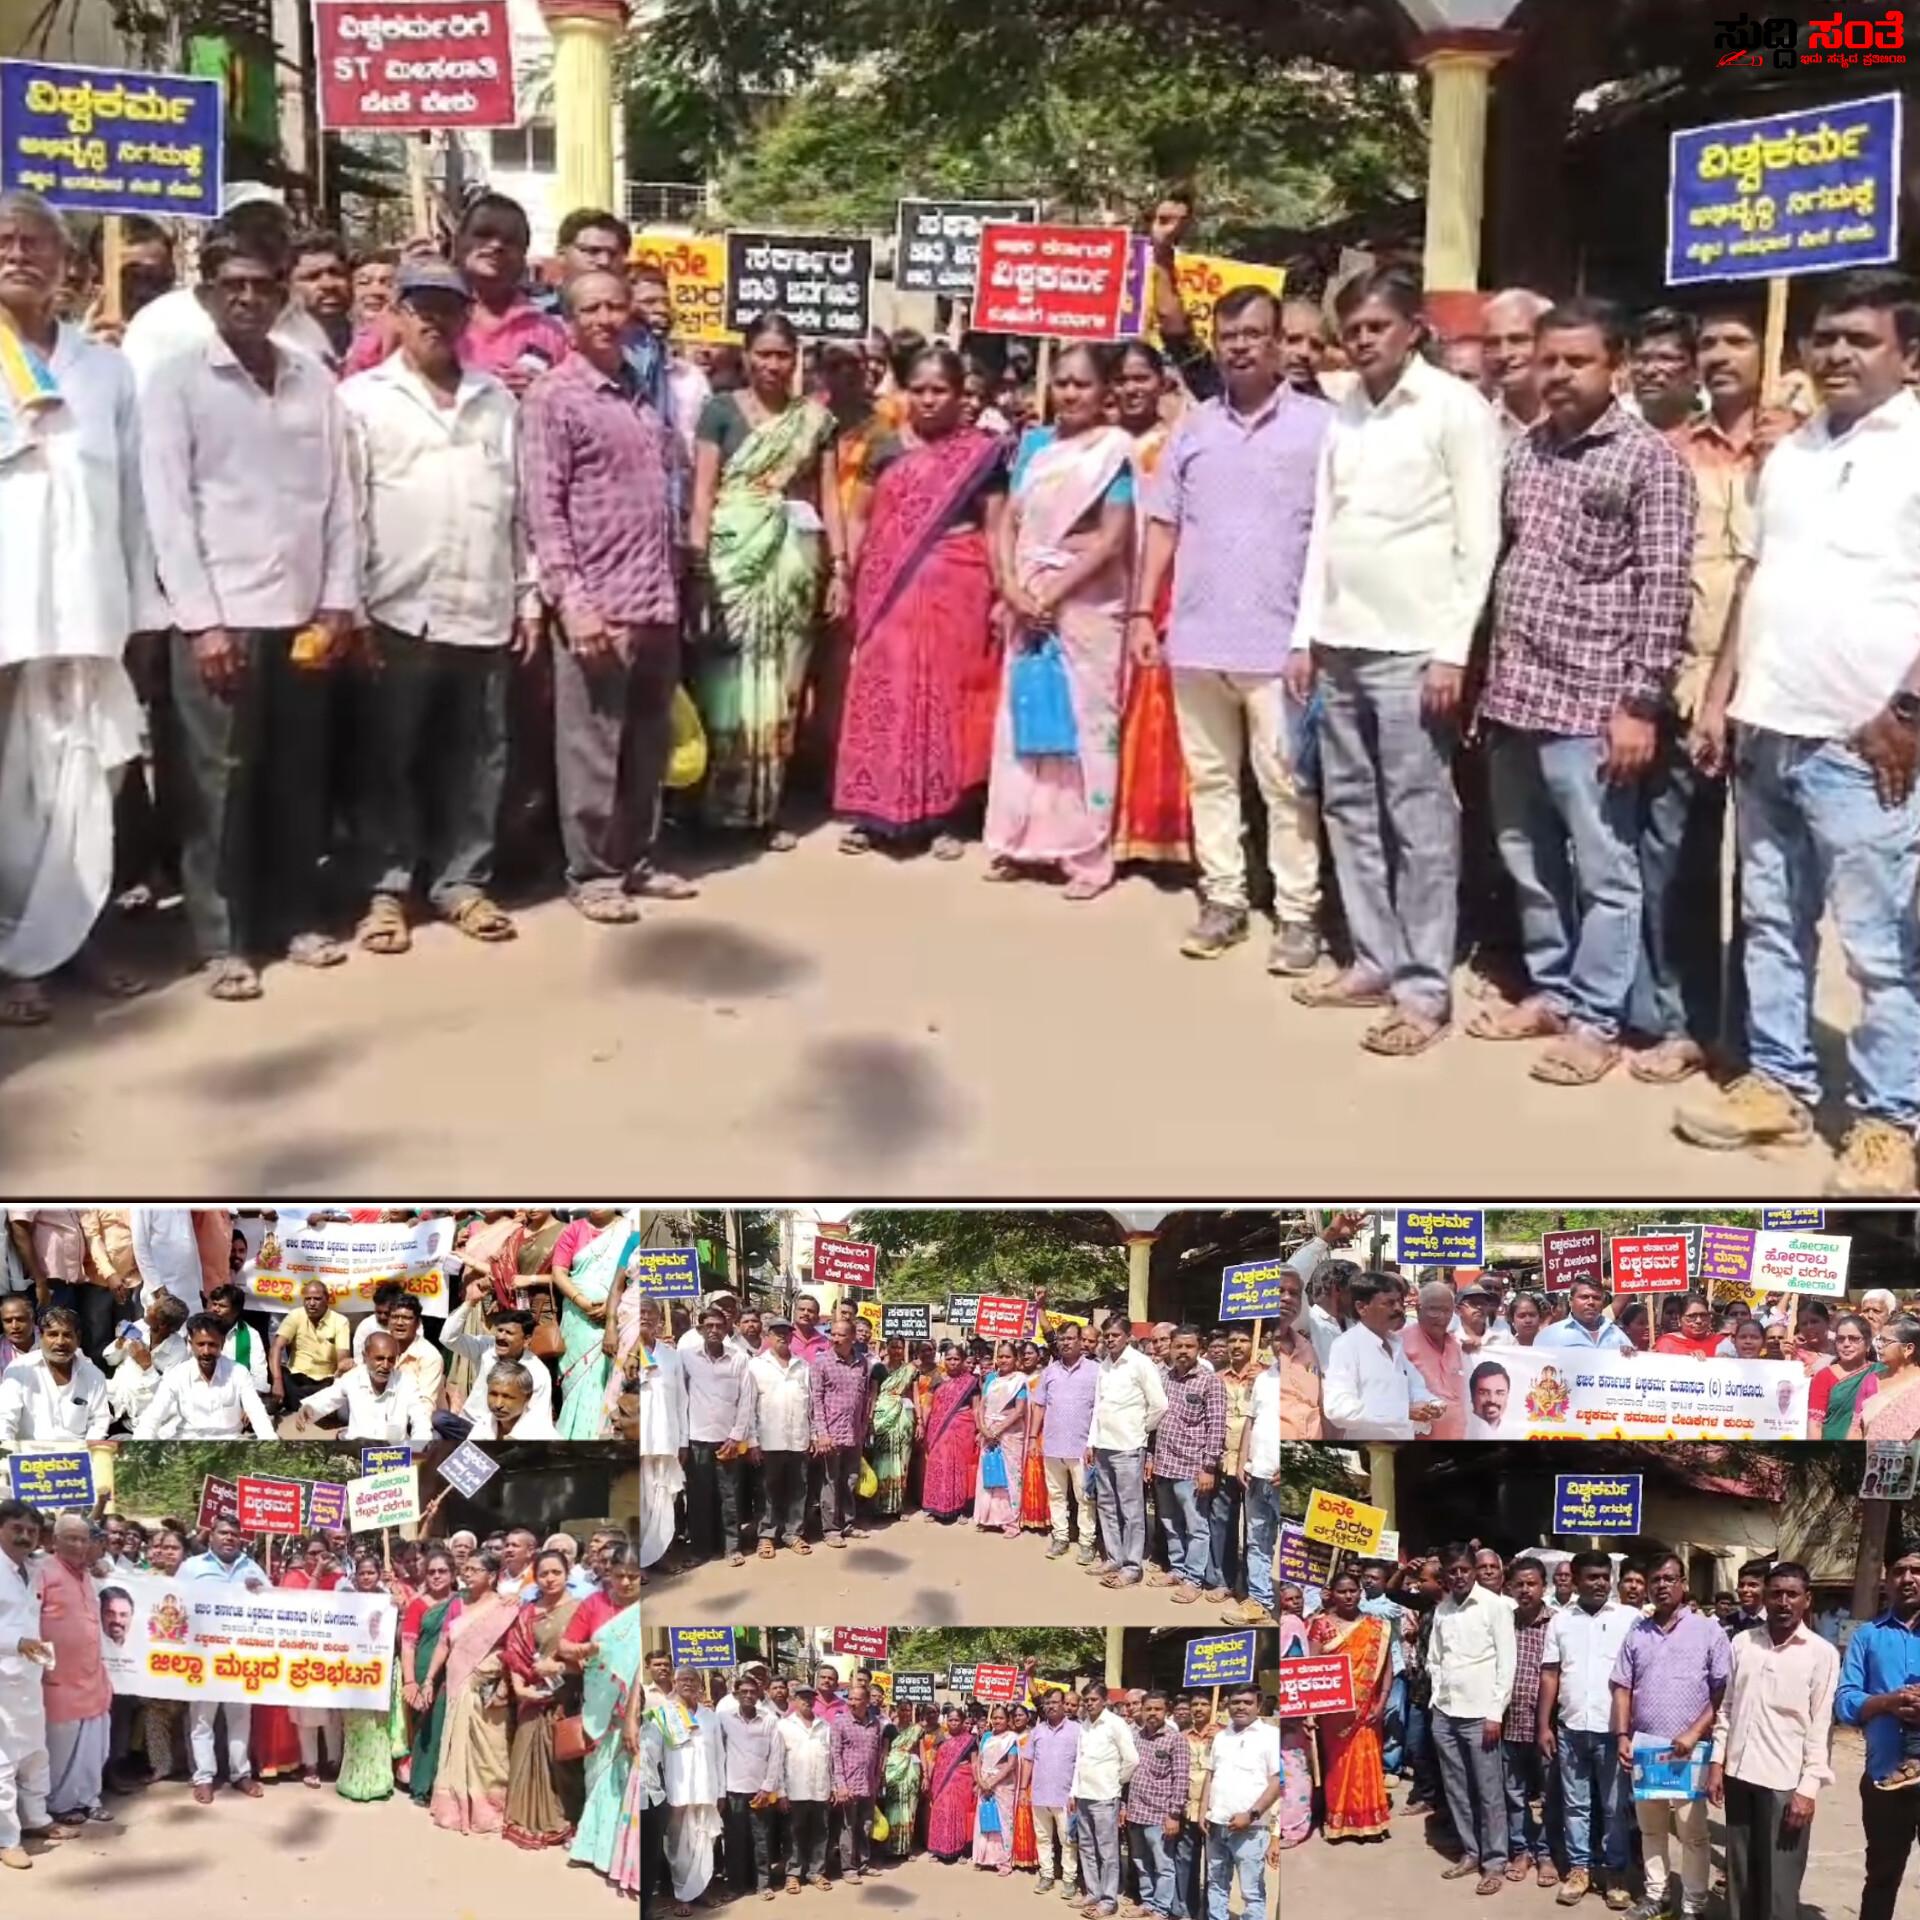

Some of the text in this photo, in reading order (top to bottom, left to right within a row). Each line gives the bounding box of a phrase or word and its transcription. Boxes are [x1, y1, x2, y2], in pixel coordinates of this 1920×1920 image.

[333, 56, 371, 81] ST
[25, 80, 196, 133] ವಿಶ್ವಕರ್ಮ
[1698, 122, 1869, 194] ವಿಶ್ವಕರ್ಮ
[745, 240, 854, 274] ಸರ್ಕಾರ
[991, 261, 1109, 304] ವಿಶ್ವಕರ್ಮ
[1183, 262, 1222, 294] ನೇ
[676, 284, 722, 305] ಬರ
[1407, 1212, 1473, 1235] ವಿಶ್ವಕರ್ಮ
[1789, 1238, 1839, 1252] ಹೋರಾಟ
[818, 1256, 831, 1265] ST
[1548, 1258, 1561, 1270] ST
[1619, 1256, 1680, 1278] ವಿಶ್ವಕರ್ಮ
[1765, 1248, 1828, 1265] ಹೋರಾಟ
[1787, 1276, 1835, 1290] ಹೋರಾಟ
[1567, 1480, 1631, 1503] ವಿಶ್ವಕರ್ಮ
[1318, 1497, 1354, 1518] ಏನೇ
[838, 1630, 848, 1639] ST
[150, 1653, 201, 1683] ಜಿಲ್ಲಾ
[215, 1652, 279, 1690] ಮಟ್ಟದ
[290, 1657, 382, 1688] ಪ್ರತಿಭಟನೆ
